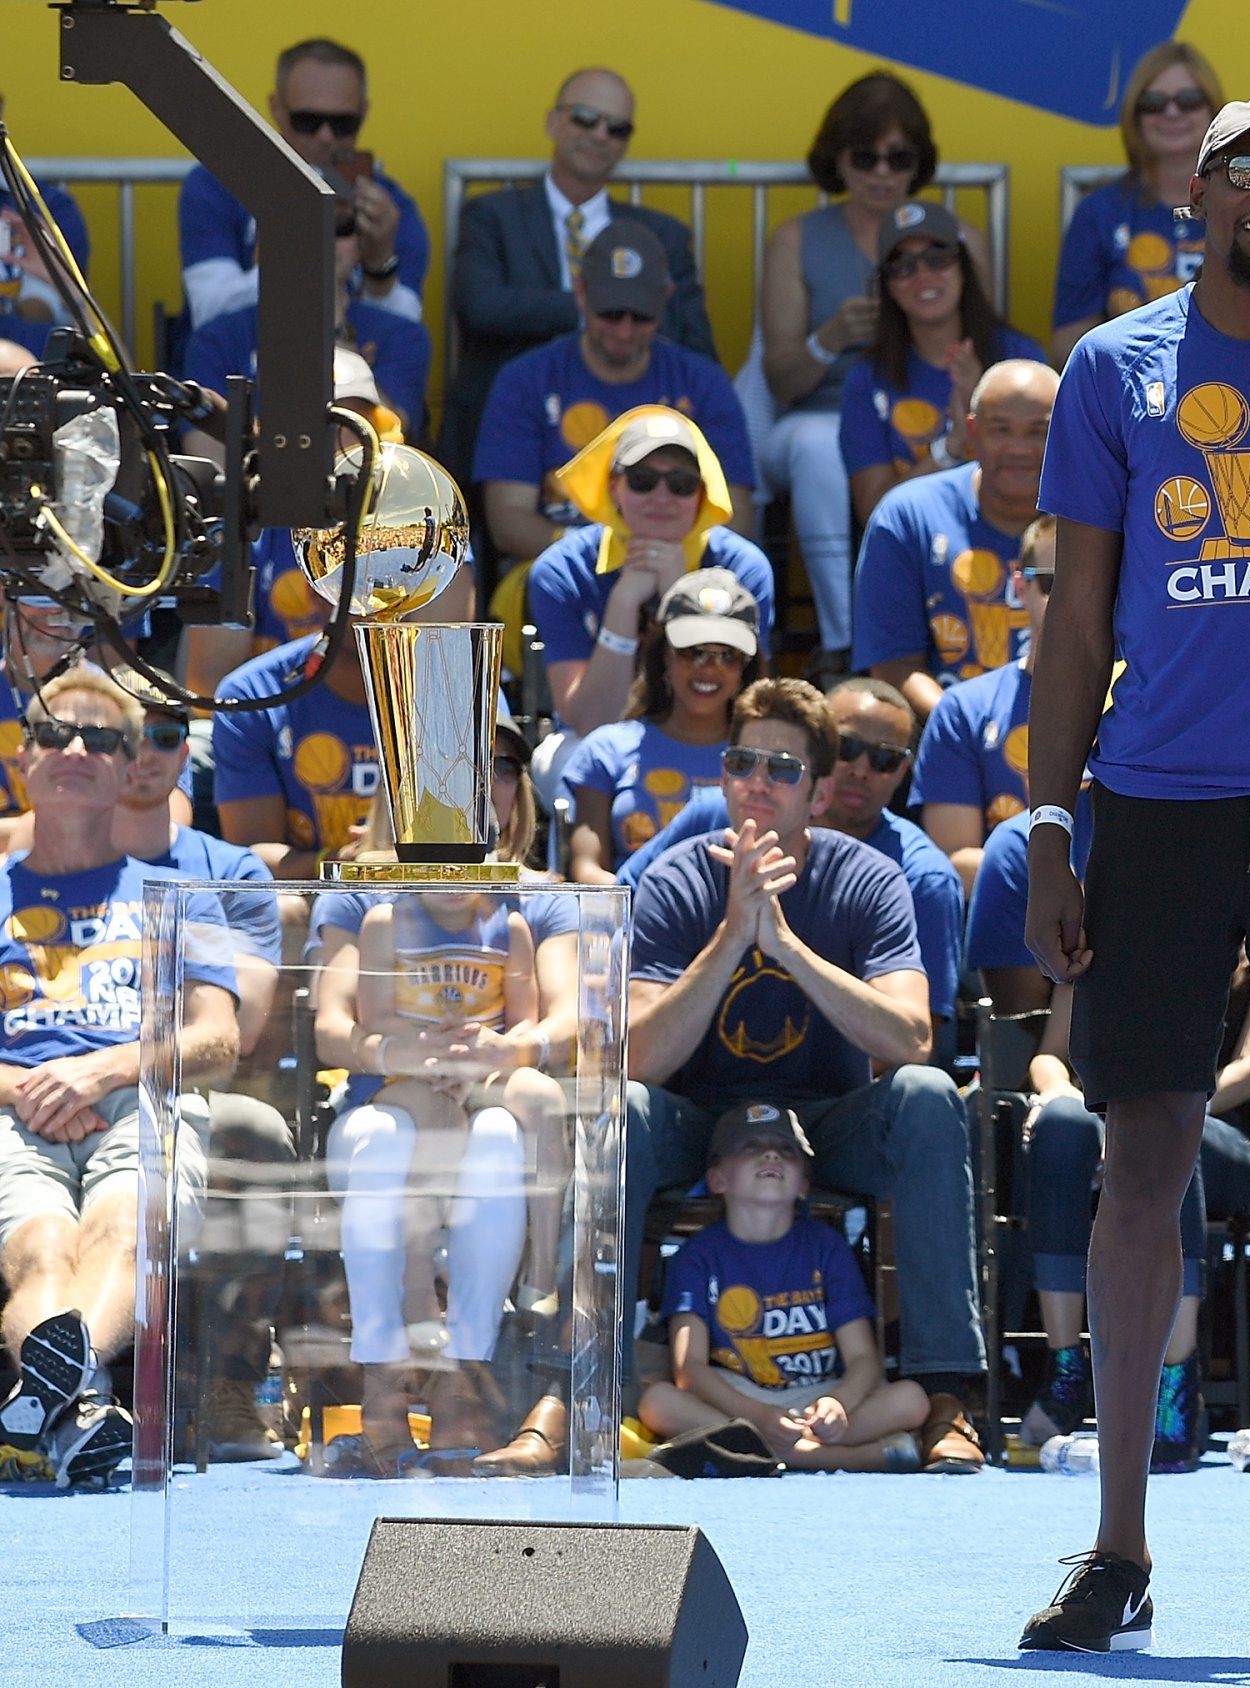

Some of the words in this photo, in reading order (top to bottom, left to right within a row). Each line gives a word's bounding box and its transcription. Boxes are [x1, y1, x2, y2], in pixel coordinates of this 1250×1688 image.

[4, 1003, 141, 1036] CHAMP
[763, 1303, 828, 1338] DAY
[775, 1346, 839, 1376] 2017
